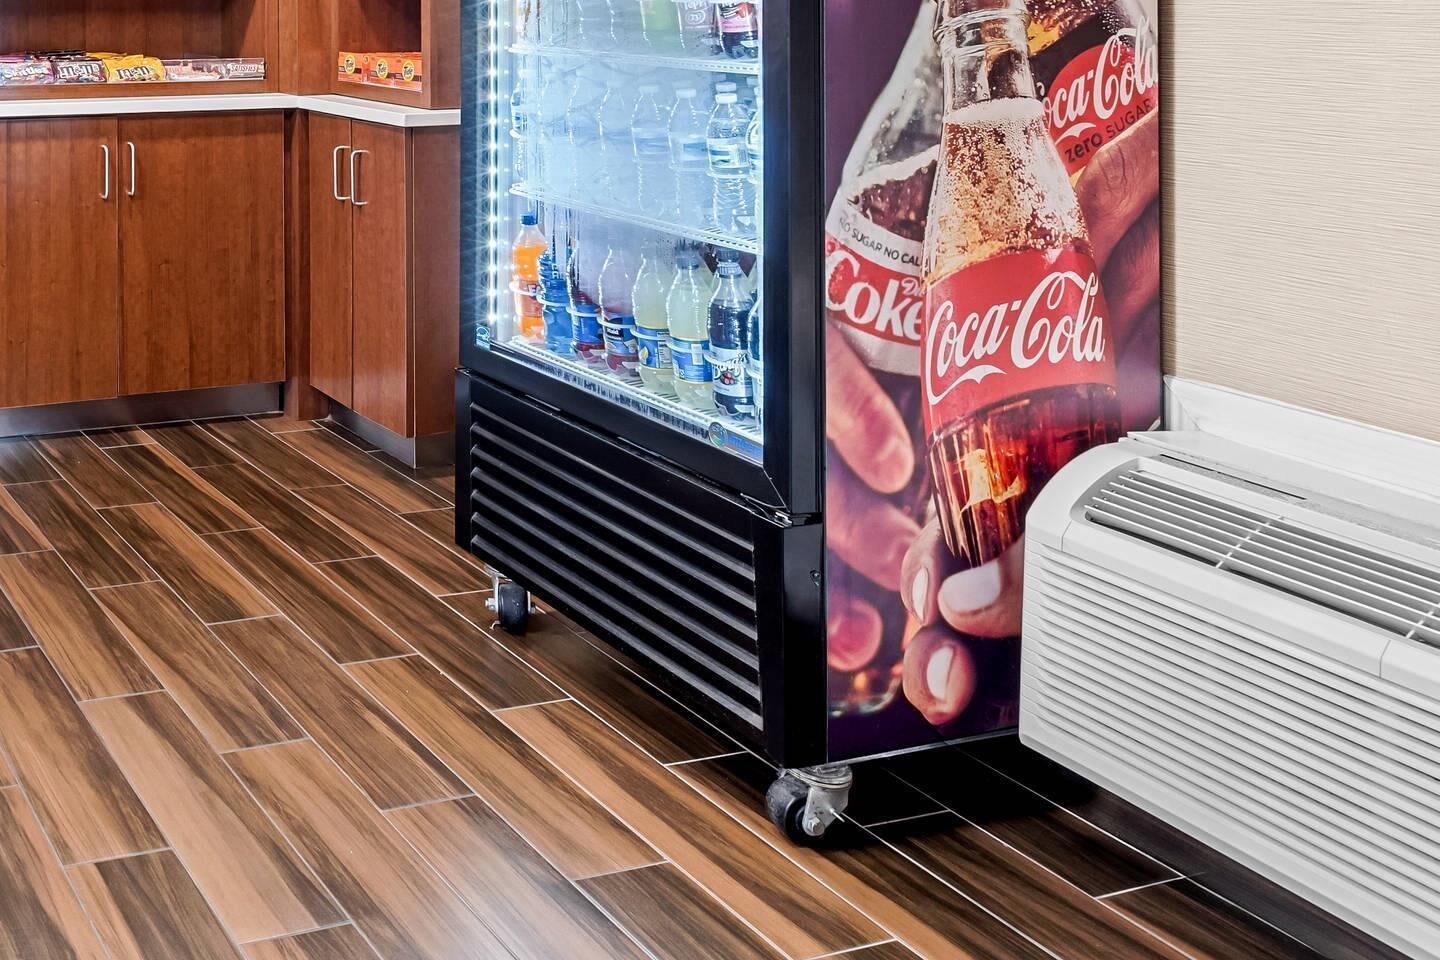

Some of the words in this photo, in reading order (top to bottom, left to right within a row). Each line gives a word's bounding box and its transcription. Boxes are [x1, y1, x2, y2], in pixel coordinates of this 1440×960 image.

[1064, 132, 1103, 164] zero
[852, 228, 883, 252] SUGAR
[884, 246, 900, 261] NO
[924, 271, 1106, 406] Coca-Cola
